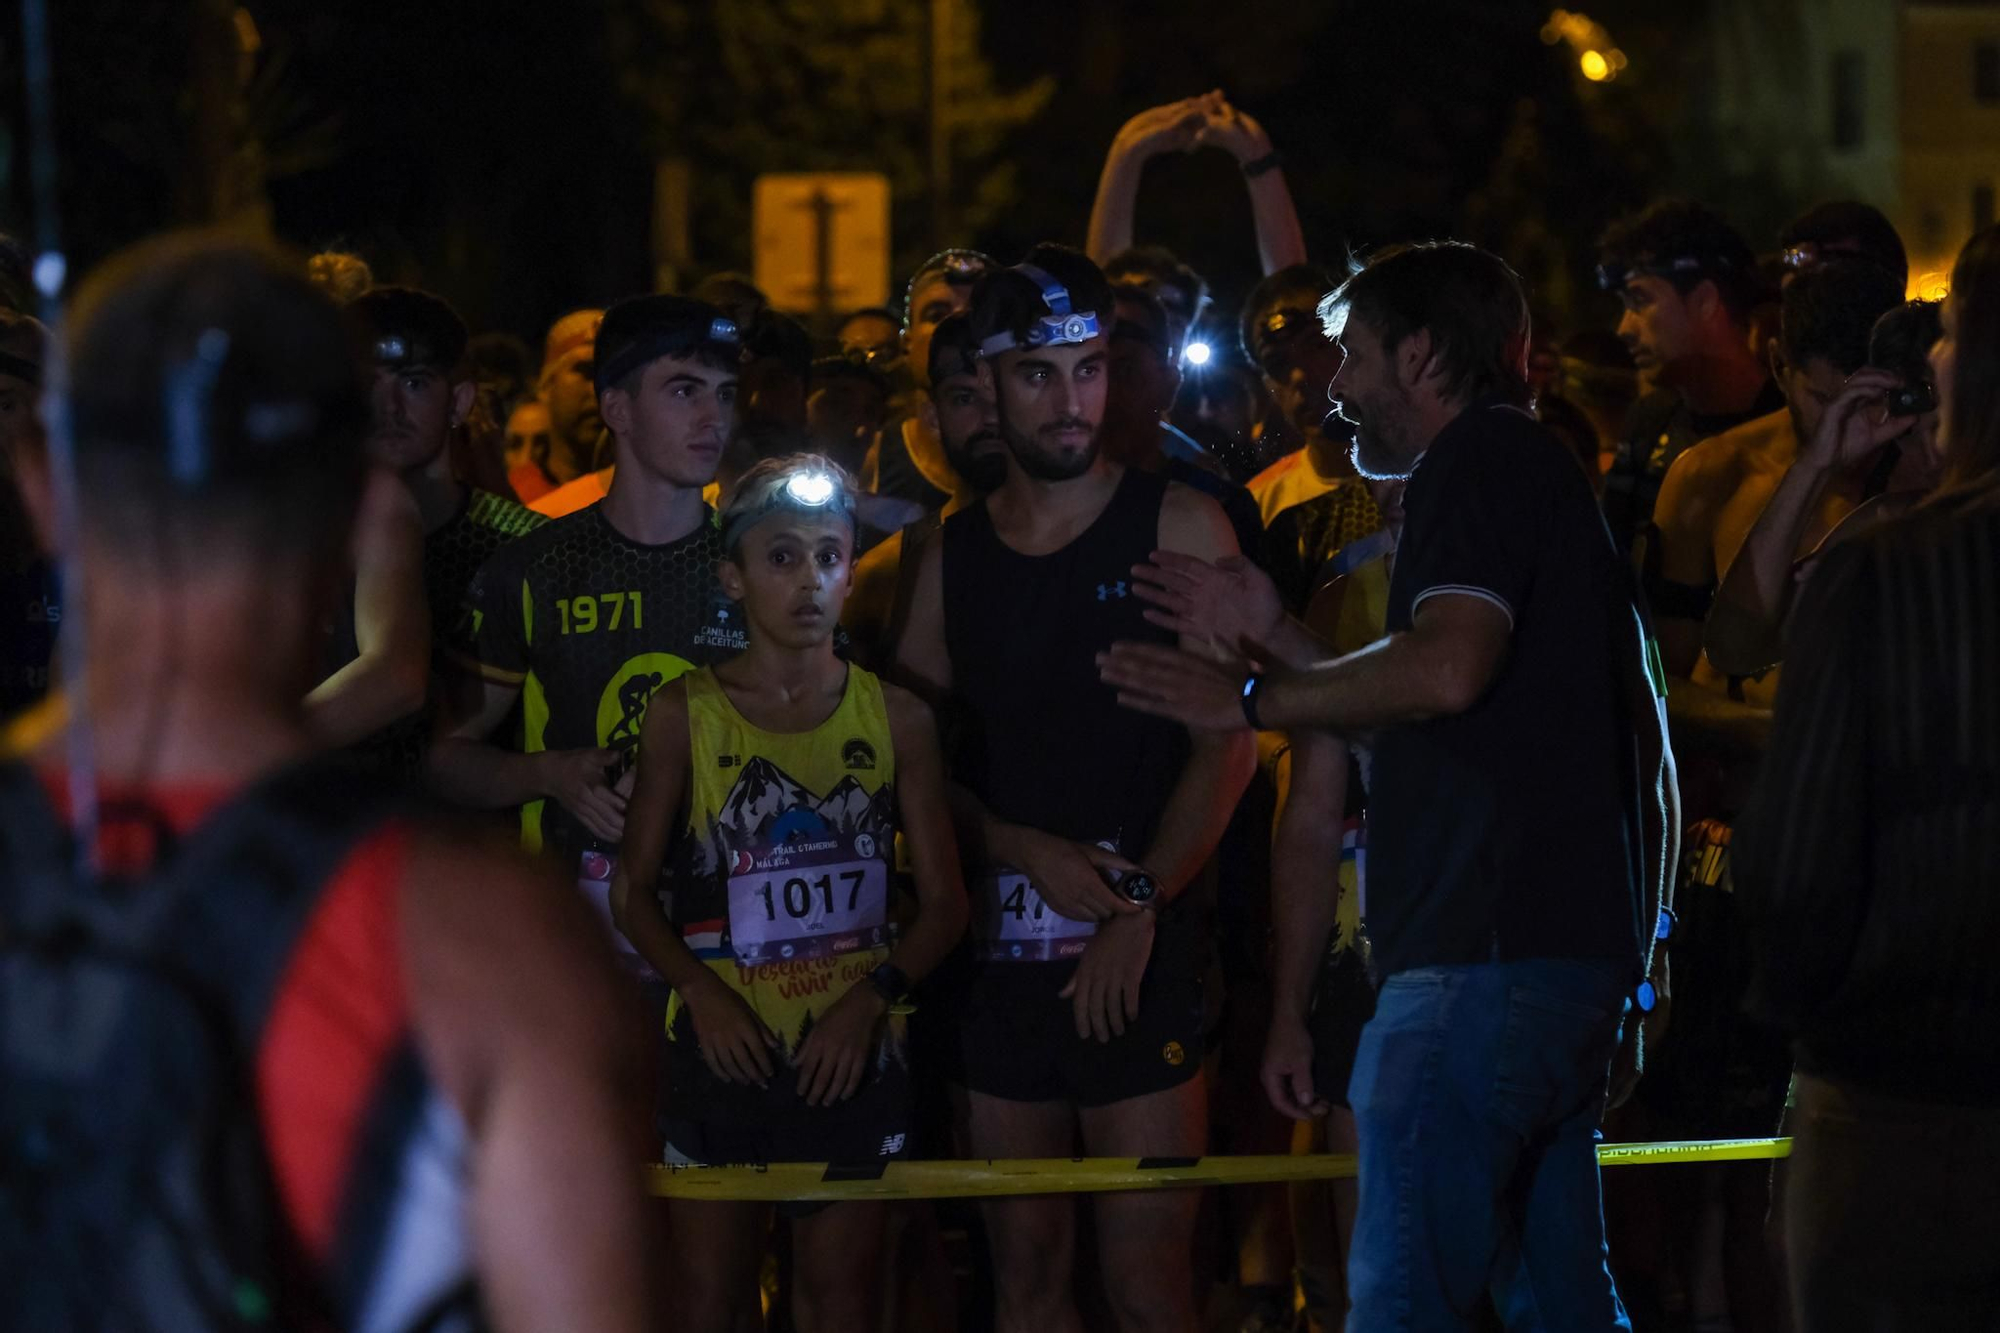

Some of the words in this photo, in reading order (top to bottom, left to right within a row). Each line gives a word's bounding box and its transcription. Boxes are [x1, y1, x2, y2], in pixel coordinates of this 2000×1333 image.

[555, 590, 643, 636] 1971
[701, 625, 745, 641] CANILLAS
[754, 869, 866, 921] 1017
